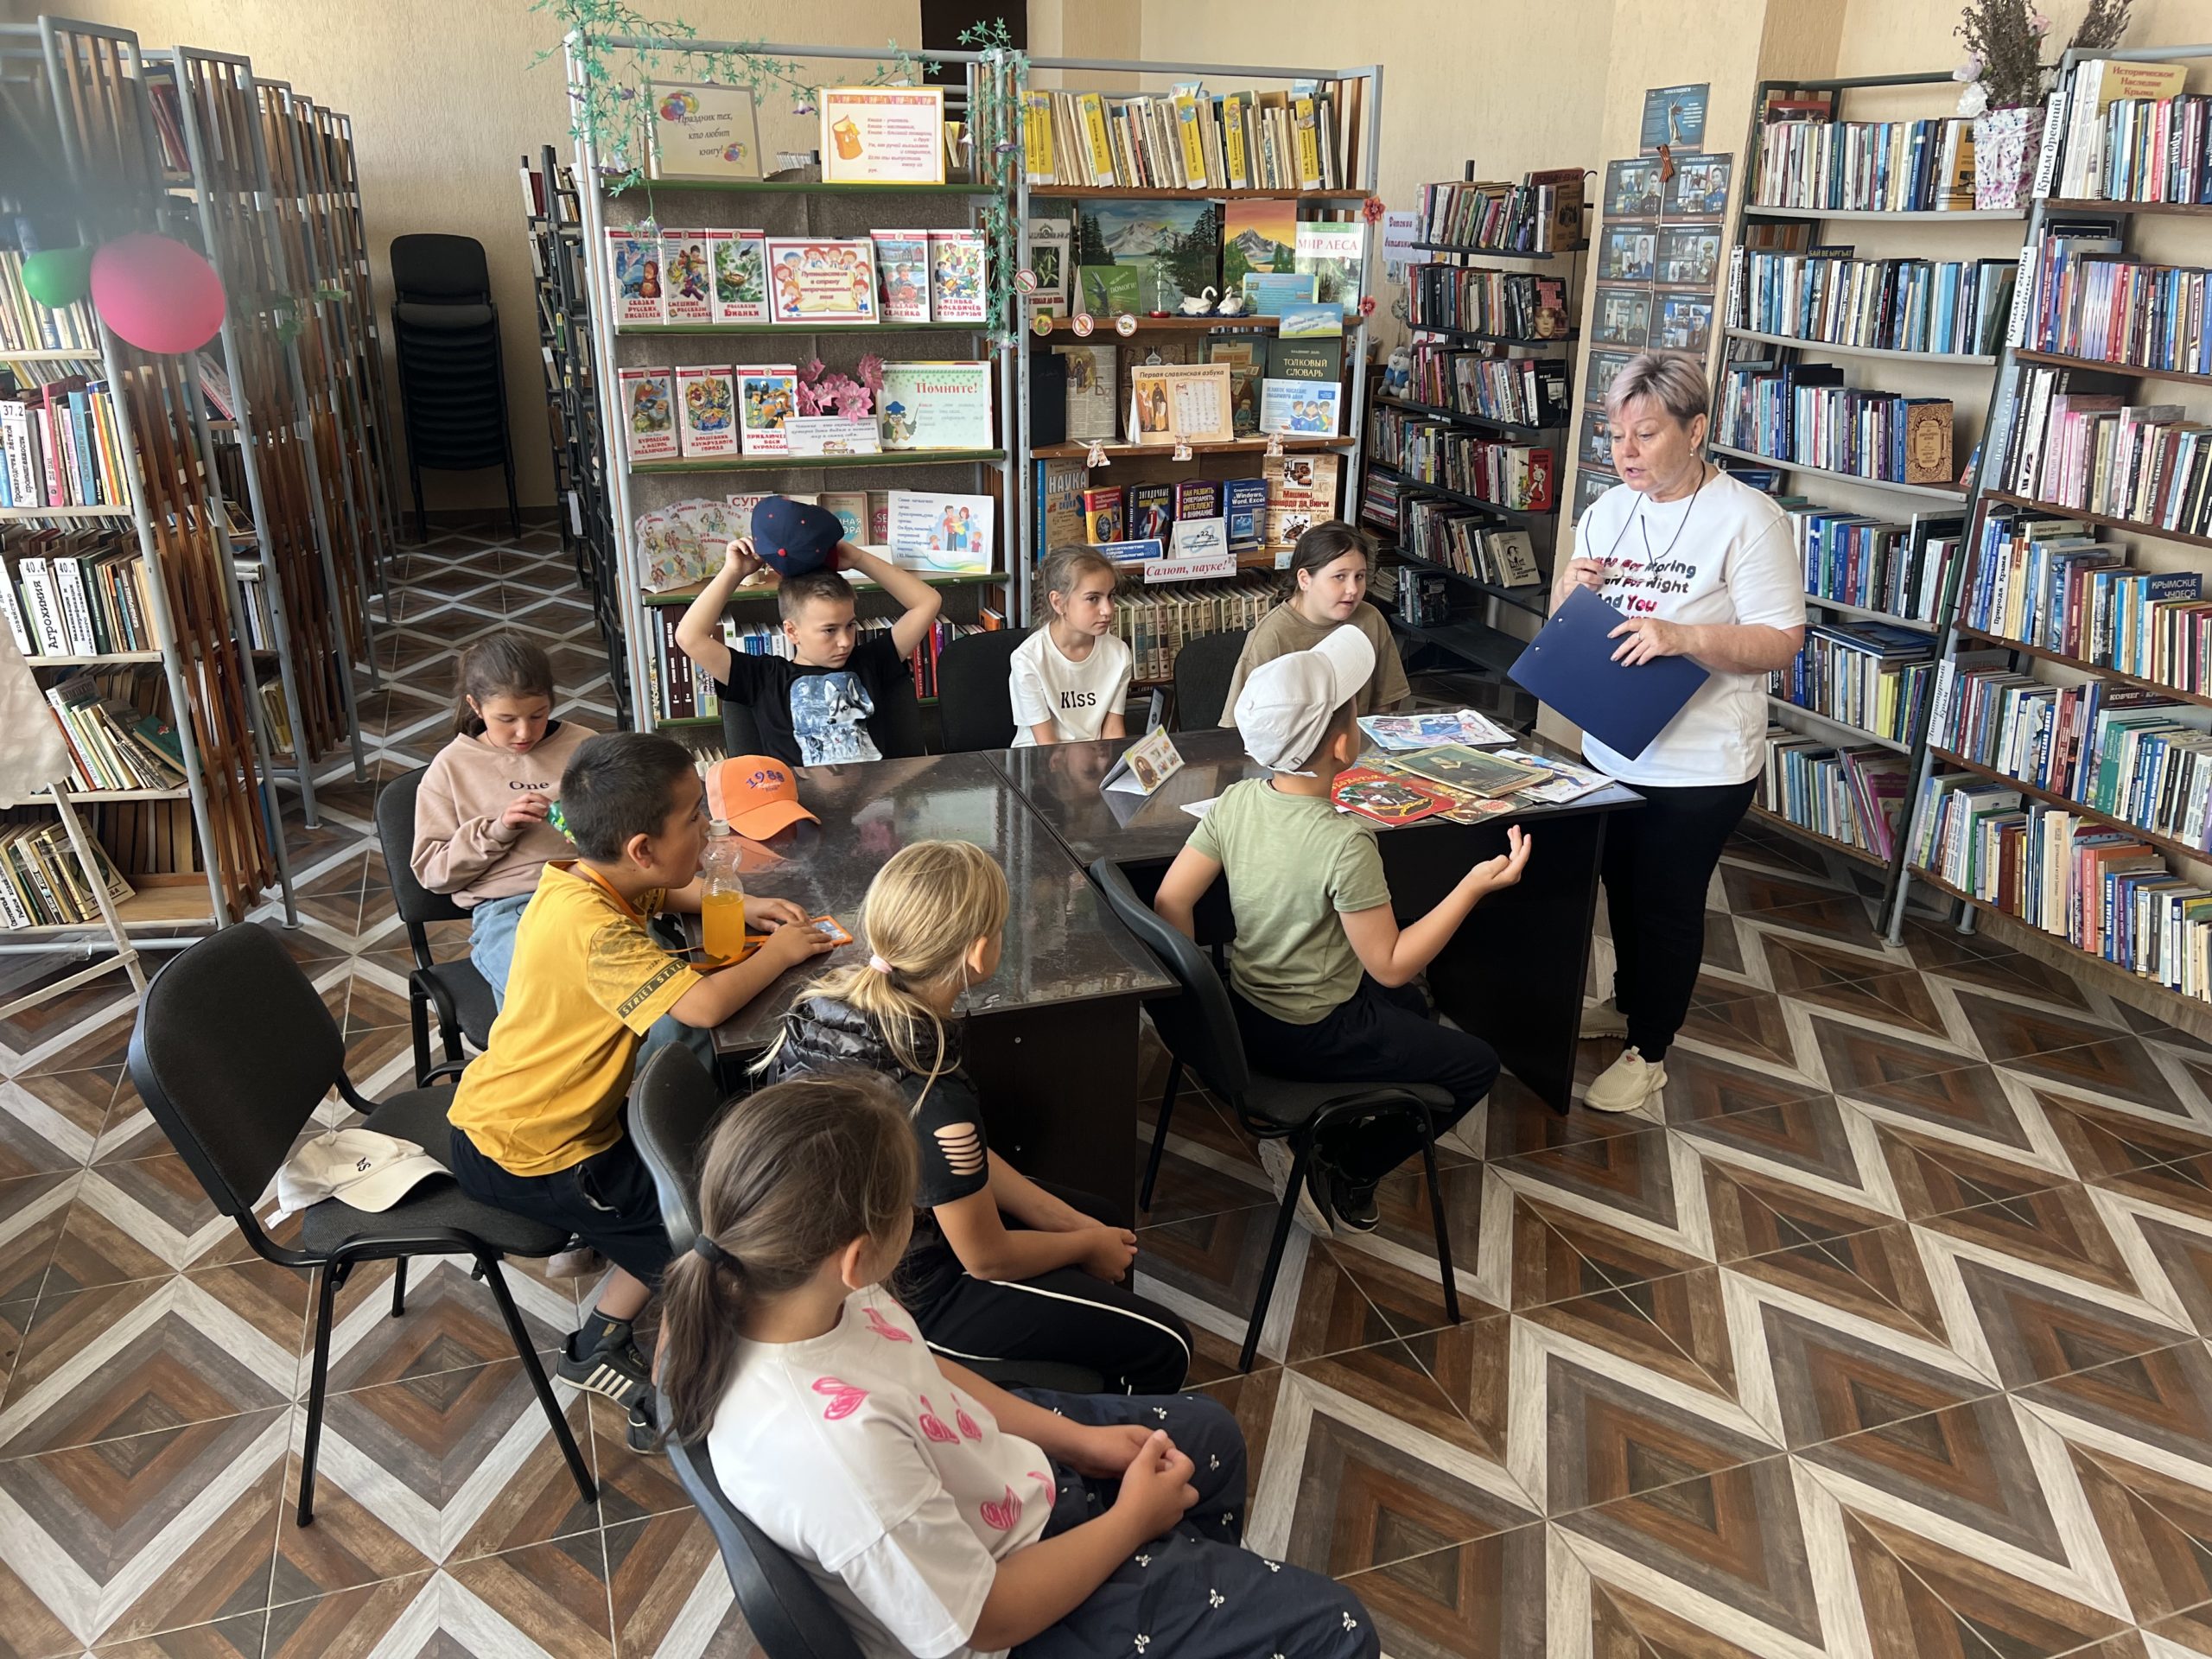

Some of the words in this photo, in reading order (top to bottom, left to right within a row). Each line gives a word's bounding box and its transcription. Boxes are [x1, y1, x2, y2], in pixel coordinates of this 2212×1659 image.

[2113, 66, 2175, 79] Историческое
[2120, 77, 2162, 87] Наследие
[2124, 87, 2154, 97] Крыма
[678, 113, 715, 125] Праздник
[2044, 99, 2062, 152] древний
[704, 127, 730, 138] любит
[699, 145, 723, 157] книгу!
[2037, 152, 2053, 193] Крым
[1298, 238, 1324, 250] МИР
[1325, 239, 1357, 251] ЛЕСА
[1809, 247, 1821, 257] БАЙ
[2006, 302, 2020, 342] Крым
[2018, 251, 2028, 287] годы
[1283, 358, 1327, 367] ТОЛКОВЫЙ
[1286, 368, 1324, 378] СЛОВАРЬ
[916, 382, 978, 394] Помните!
[3, 404, 24, 417] 37.2
[1048, 471, 1086, 494] НАУКА
[1139, 487, 1169, 499] ЗАГАДОЧНЫЕ
[1282, 490, 1313, 499] Машины
[732, 497, 765, 507] СУП
[1183, 495, 1215, 504] СУПЕРПАМЯТЬ
[1183, 501, 1213, 512] ИНТЕЛЛЕКТ
[1187, 509, 1213, 518] ВНИМАНИЕ
[26, 561, 47, 574] 40.4
[59, 562, 77, 574] 40.7
[1146, 566, 1189, 576] Салют,
[1192, 560, 1227, 574] науке!
[1644, 559, 1697, 579] Moring
[1645, 575, 1690, 594] Night
[2152, 578, 2197, 590] КРЫМСКИЕ
[1993, 588, 2004, 626] Природа
[1999, 555, 2007, 582] Крыма
[2164, 588, 2196, 599] ЧУДЕСА
[32, 580, 59, 649] Агрохимия
[1929, 664, 1947, 741] Литературный
[1939, 691, 1949, 720] Крым
[509, 780, 550, 790] One
[622, 985, 653, 1014] STREET
[657, 962, 686, 983] STYLE
